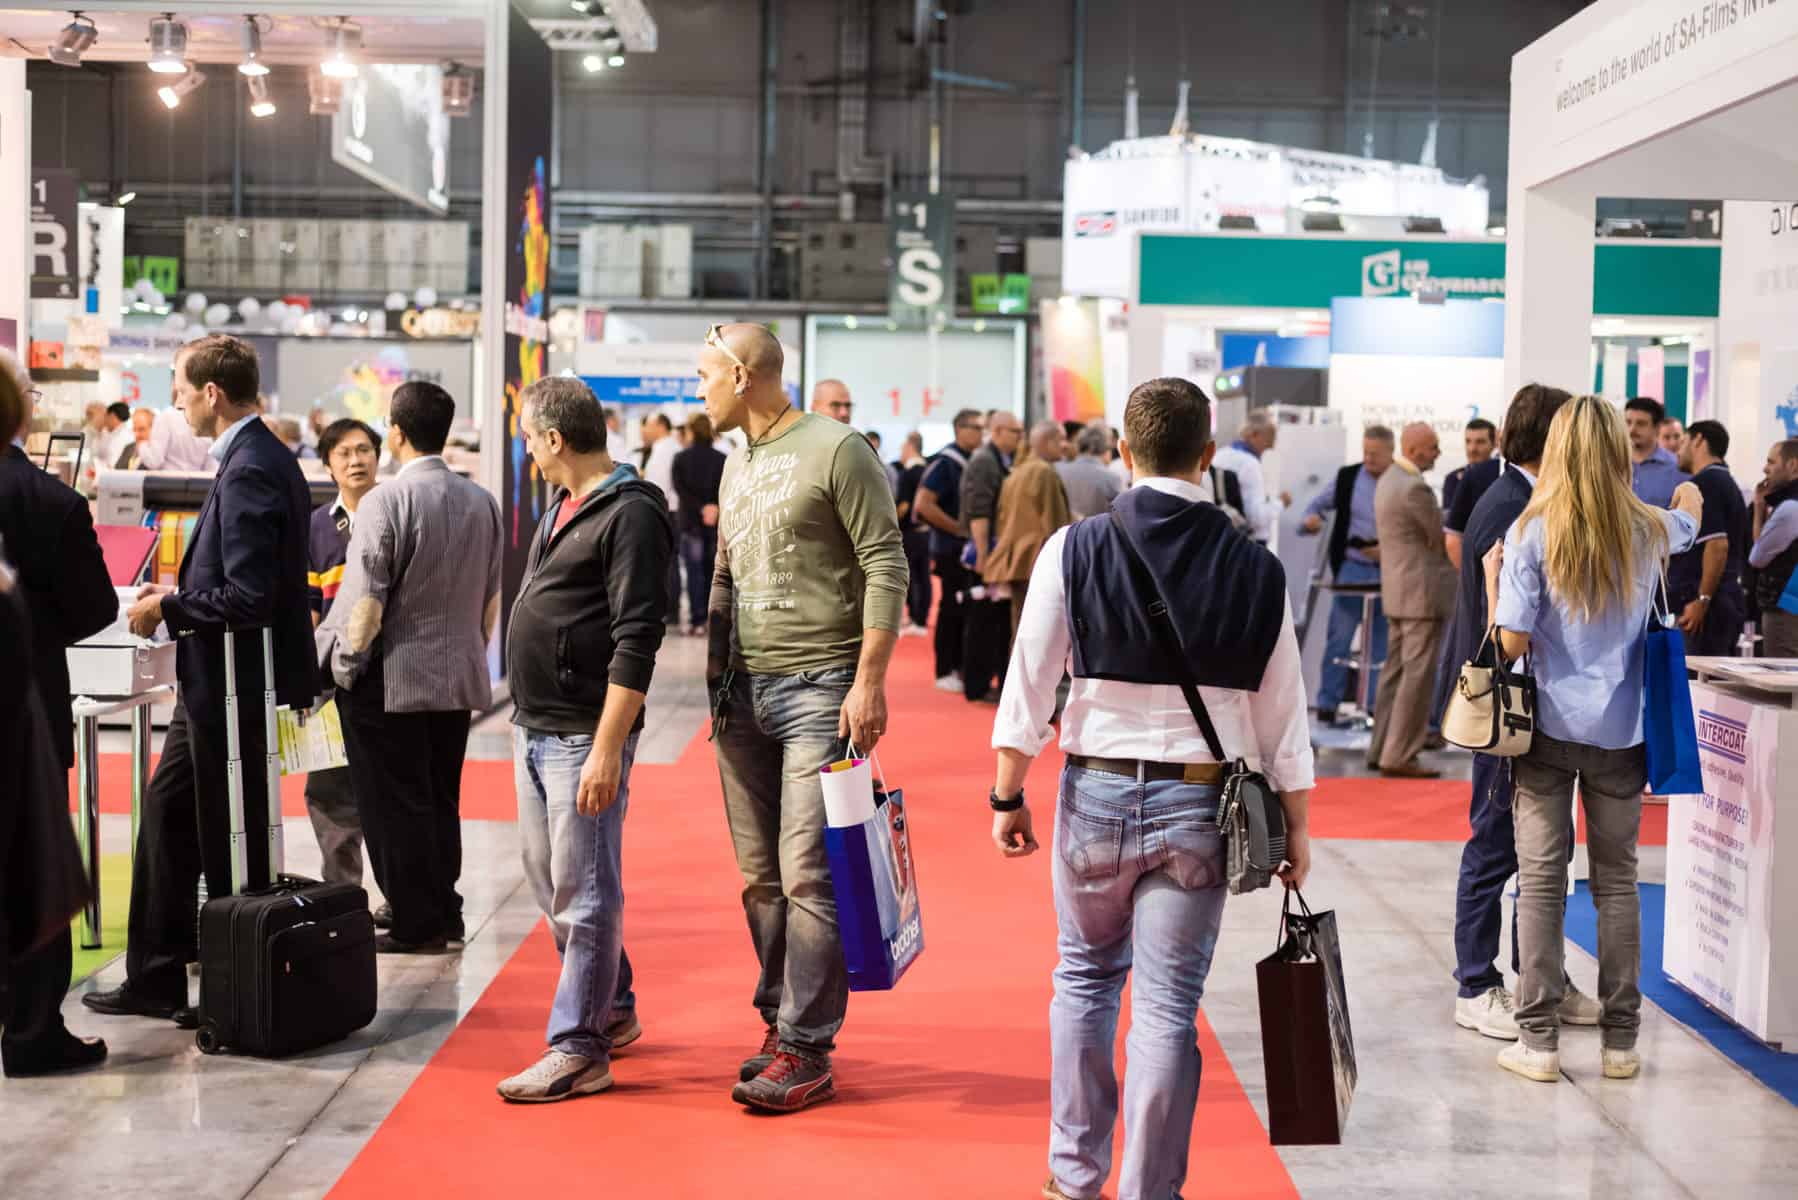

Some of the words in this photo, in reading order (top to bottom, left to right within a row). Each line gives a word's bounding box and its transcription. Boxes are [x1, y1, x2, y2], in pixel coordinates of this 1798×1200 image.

[1556, 74, 1596, 112] welcome
[1599, 67, 1609, 92] to
[1610, 55, 1628, 86] the
[1631, 32, 1661, 73] world
[1664, 22, 1679, 57] of
[1679, 2, 1738, 49] SA-Films
[34, 179, 47, 203] 1
[912, 202, 927, 228] 1
[31, 221, 68, 276] R
[898, 248, 944, 305] S
[1697, 719, 1747, 753] INTERCOAT
